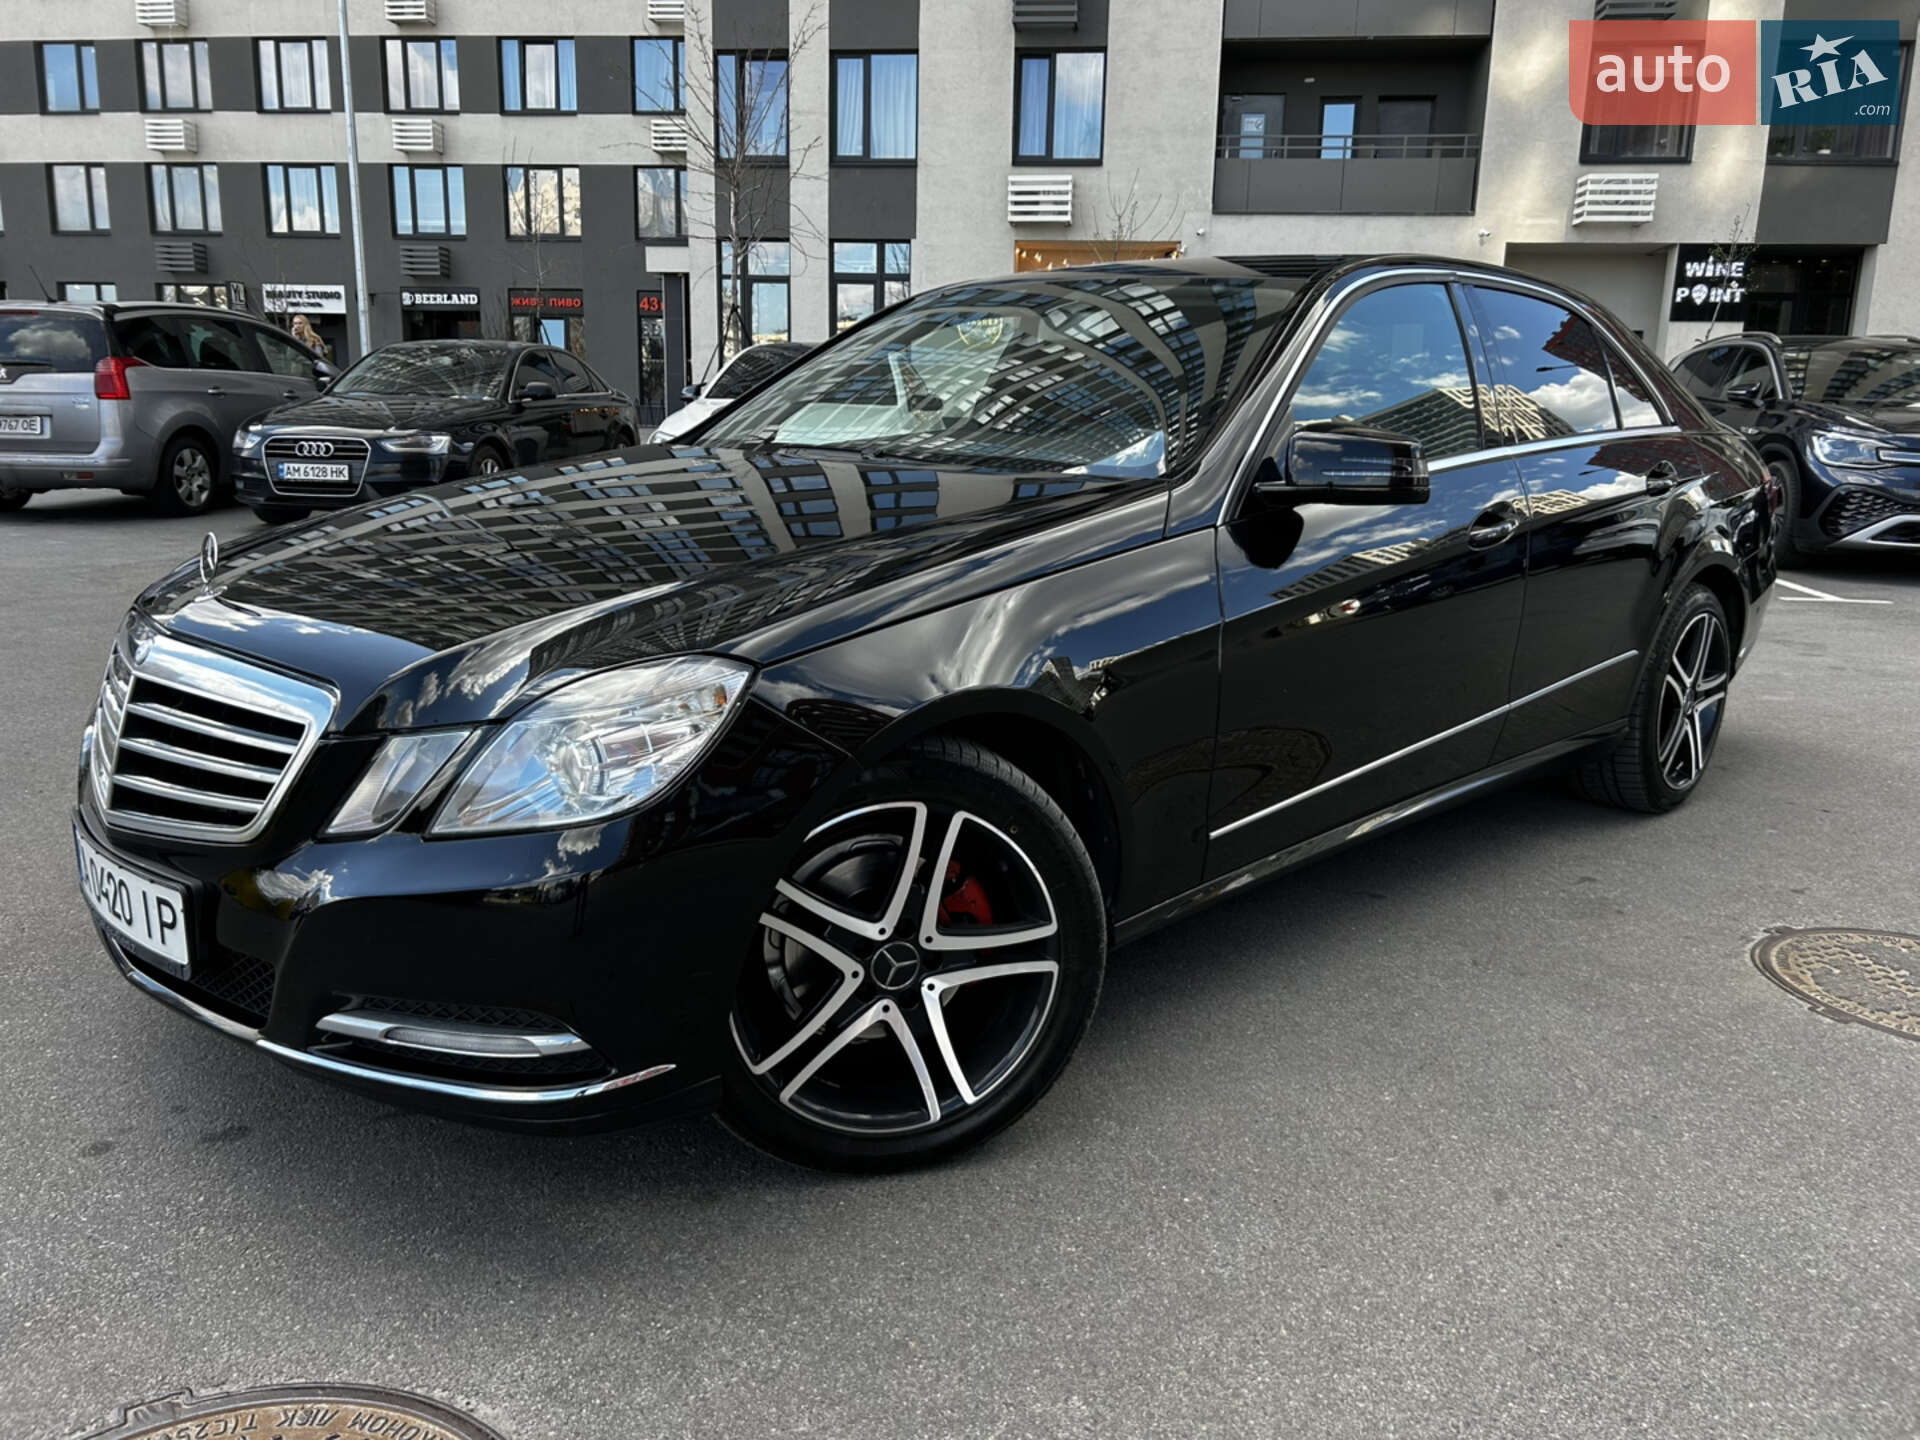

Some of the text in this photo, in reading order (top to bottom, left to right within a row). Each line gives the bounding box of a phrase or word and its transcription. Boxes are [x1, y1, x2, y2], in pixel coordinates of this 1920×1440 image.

[304, 290, 342, 300] STUDIO
[414, 293, 478, 305] BEERLAND
[549, 297, 581, 308] ПИВО
[0, 419, 19, 431] 767
[303, 466, 328, 478] 6128
